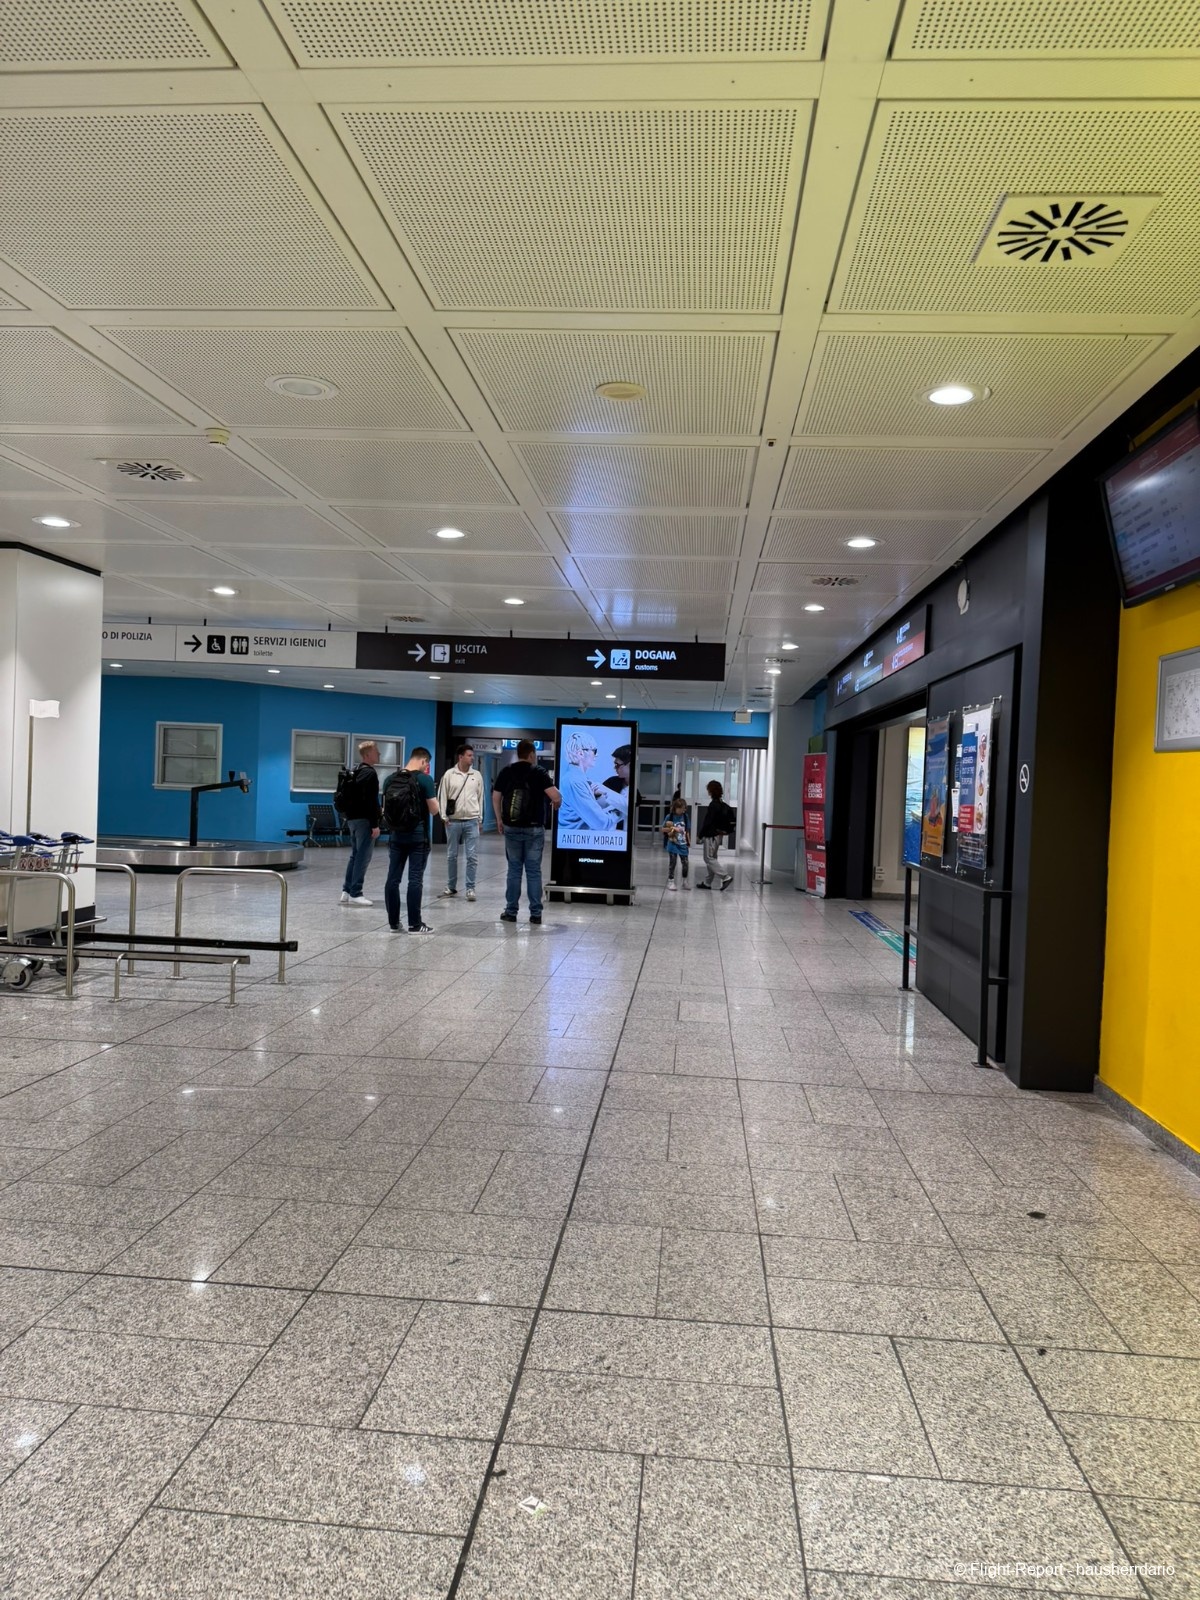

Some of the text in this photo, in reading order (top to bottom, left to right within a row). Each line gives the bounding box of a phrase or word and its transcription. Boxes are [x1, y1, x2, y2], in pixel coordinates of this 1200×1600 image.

[110, 631, 119, 640] DI
[121, 632, 152, 640] POLIZIA
[253, 636, 327, 648] SERVIZI IGIENICI
[253, 649, 273, 657] toilette
[455, 644, 488, 654] USCITA
[635, 650, 677, 660] DOGANA
[561, 834, 623, 846] ANTONY MORATO
